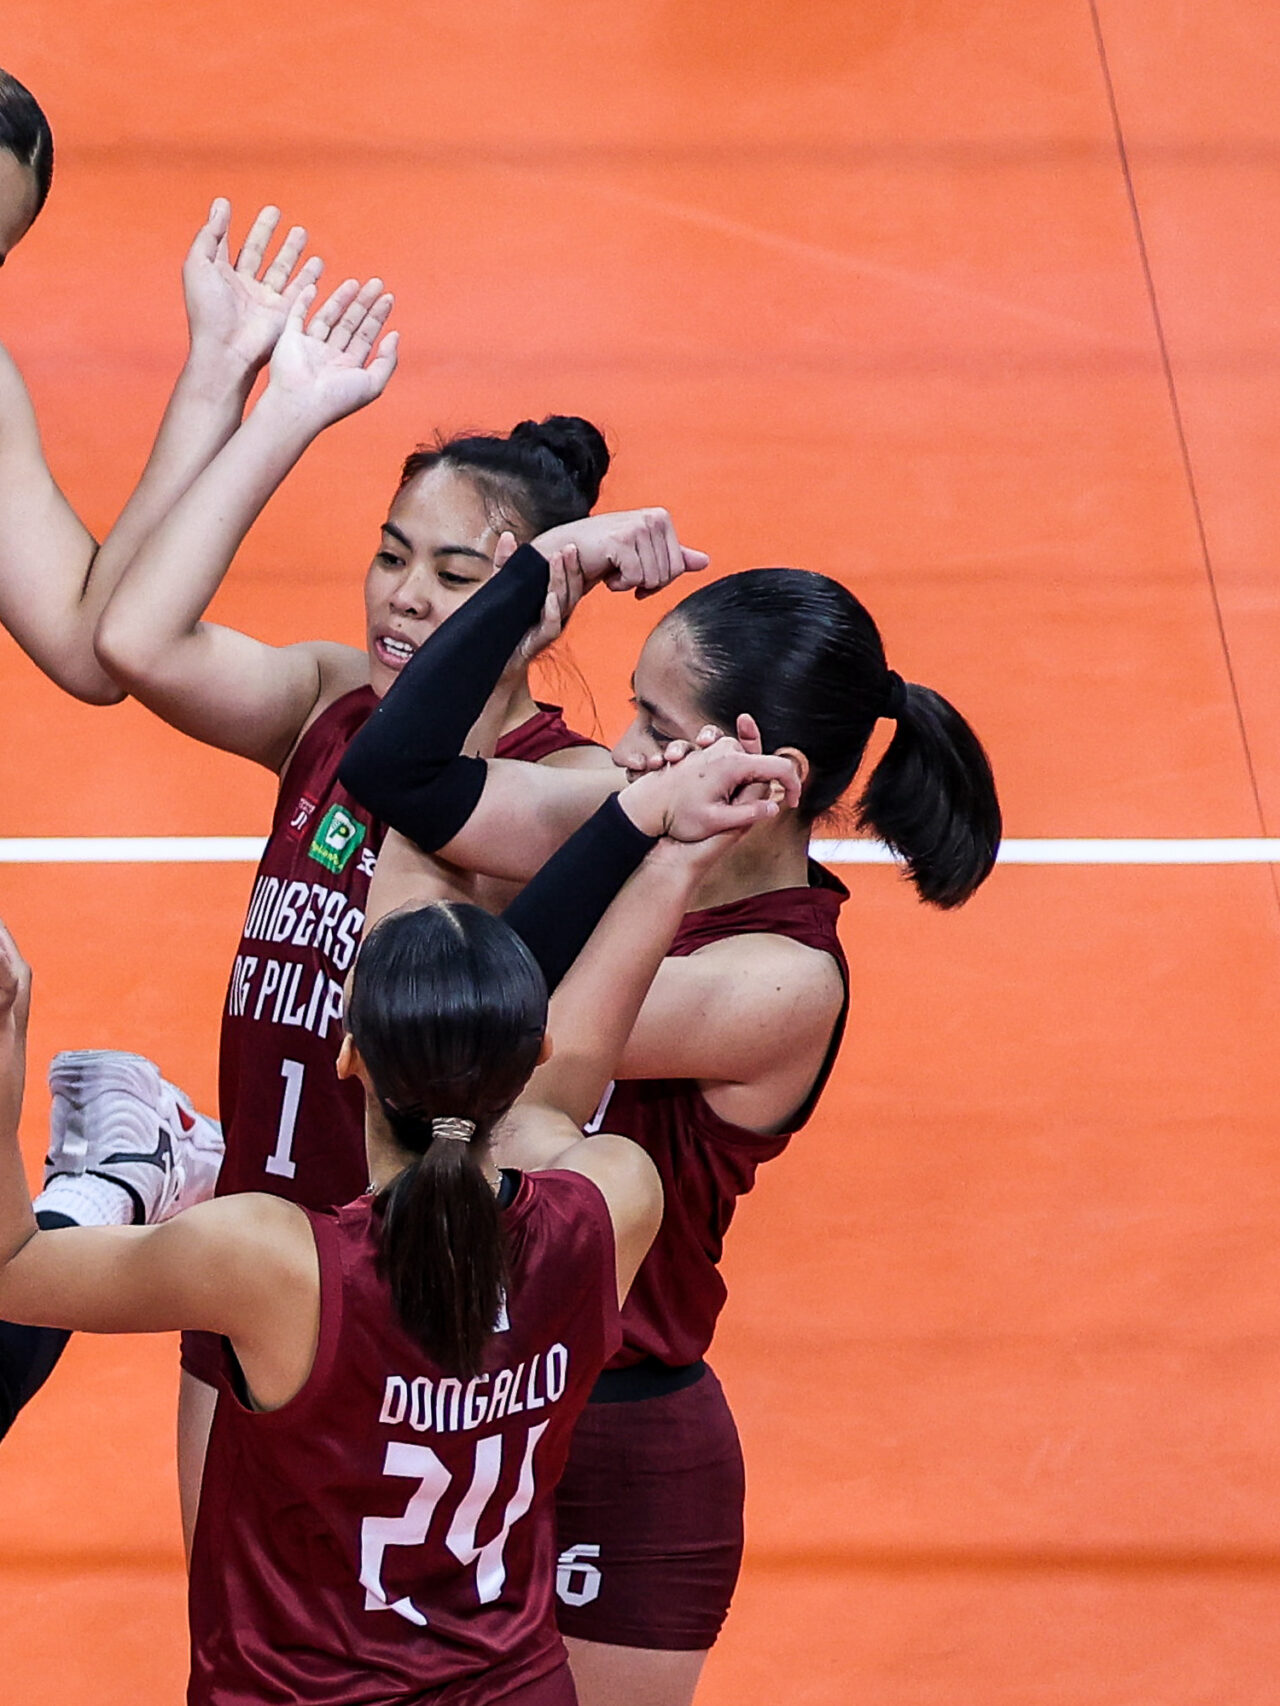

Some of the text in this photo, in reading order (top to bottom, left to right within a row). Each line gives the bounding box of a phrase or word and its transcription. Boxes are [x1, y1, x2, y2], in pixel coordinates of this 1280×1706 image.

[253, 959, 344, 1039] PILIP
[265, 1058, 305, 1180] 1
[379, 1342, 568, 1433] DONGALLO
[359, 1418, 550, 1626] 24
[556, 1544, 602, 1607] 6
